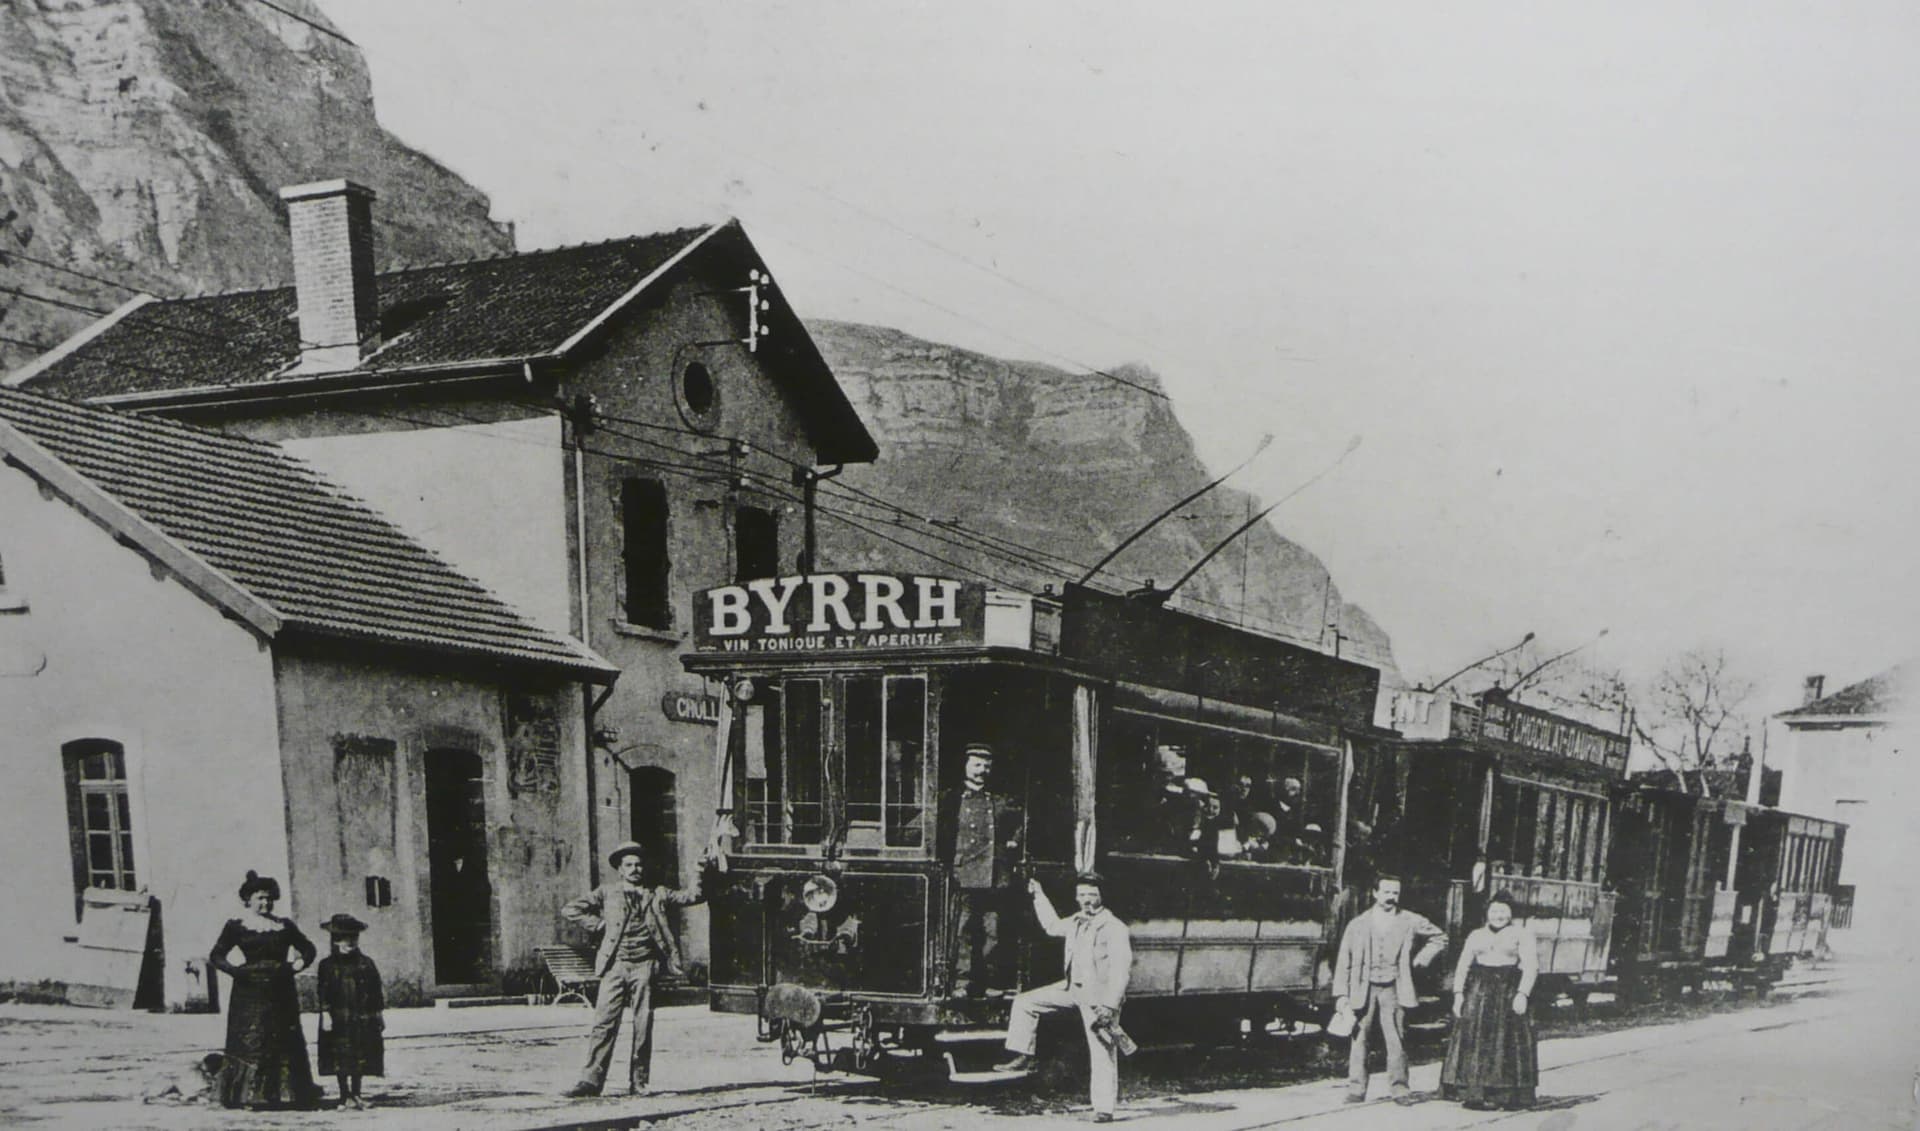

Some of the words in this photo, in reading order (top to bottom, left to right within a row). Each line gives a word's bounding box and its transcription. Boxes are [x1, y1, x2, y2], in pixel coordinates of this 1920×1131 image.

[707, 574, 961, 635] BYRRH
[723, 639, 749, 651] VIN
[757, 636, 825, 650] TONIQUE
[835, 635, 856, 648] ET
[867, 633, 943, 647] APERITIF
